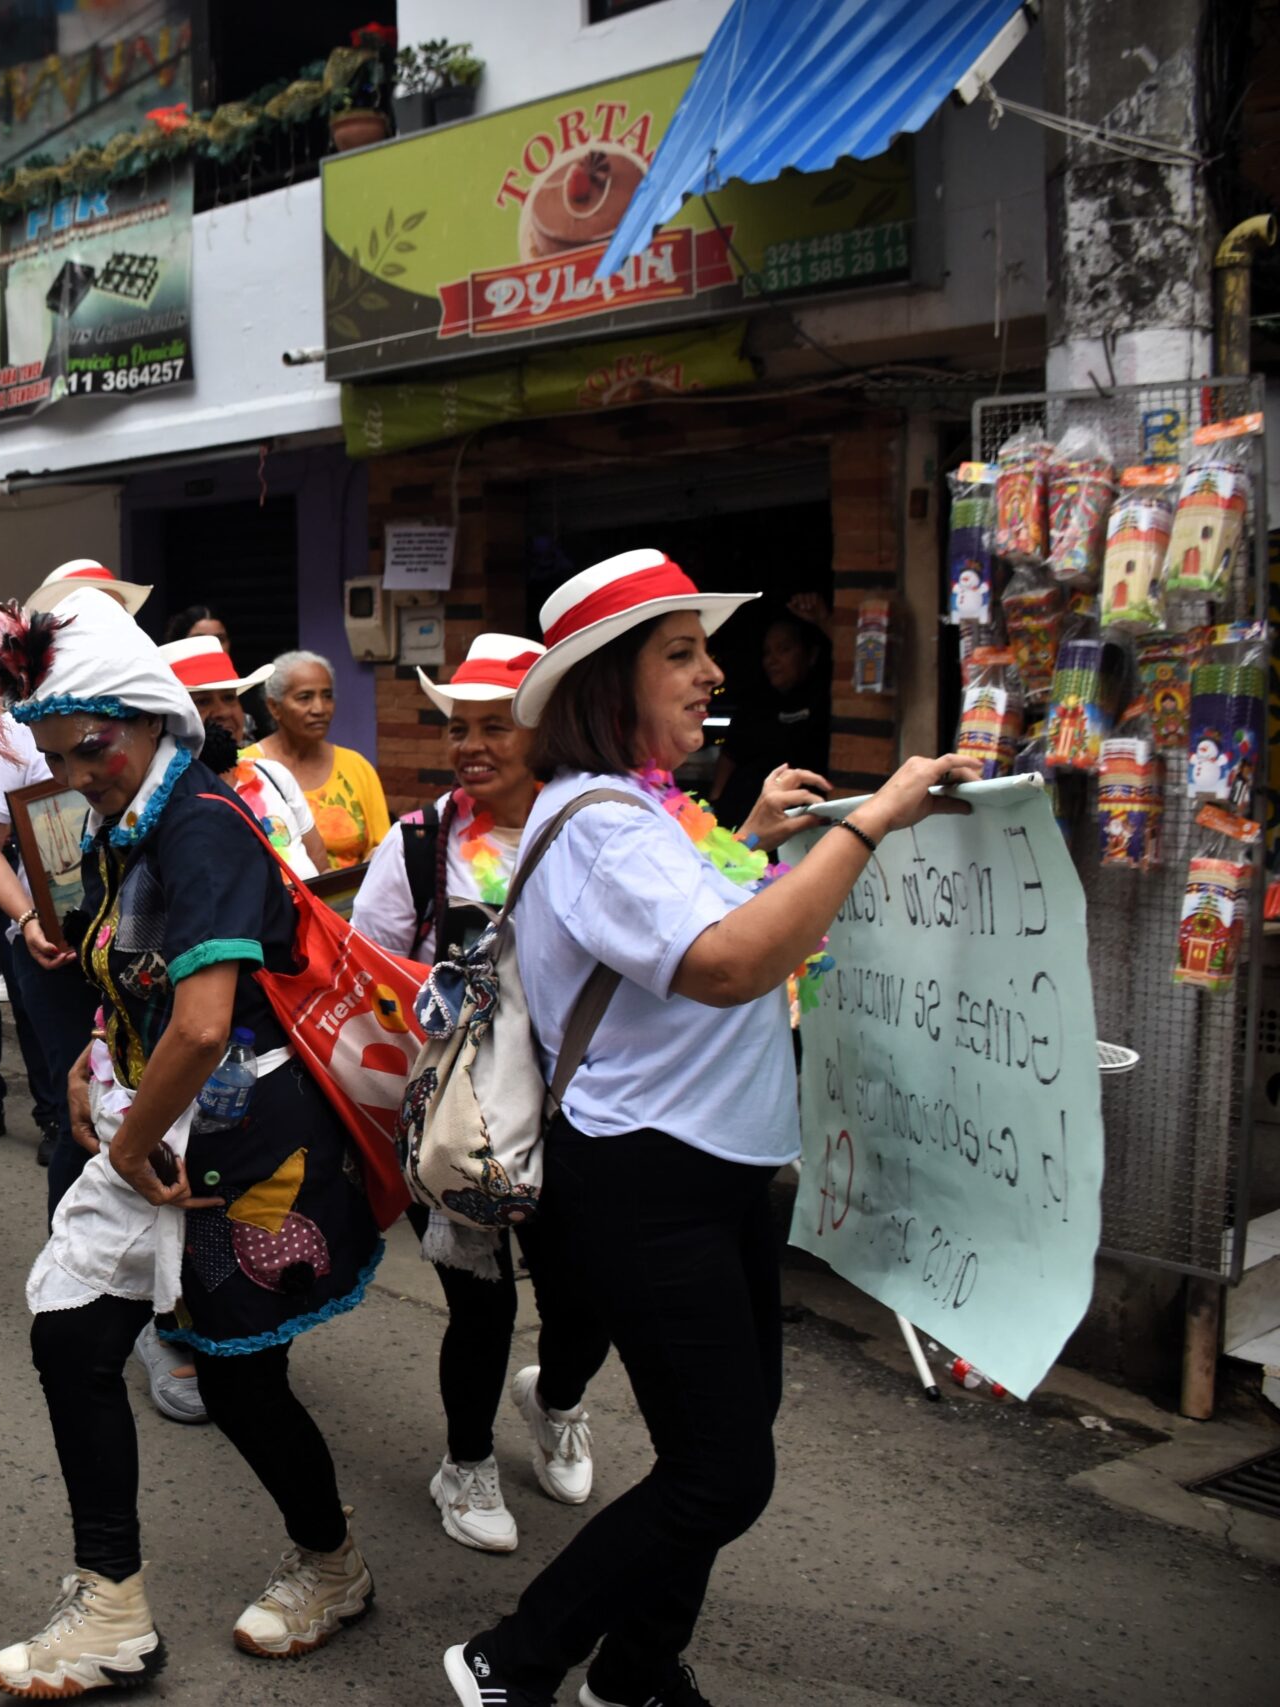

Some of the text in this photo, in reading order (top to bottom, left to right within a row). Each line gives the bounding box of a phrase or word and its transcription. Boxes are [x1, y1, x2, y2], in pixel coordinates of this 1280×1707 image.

[767, 244, 908, 291] 313 585 29 13
[101, 359, 184, 391] 3664257
